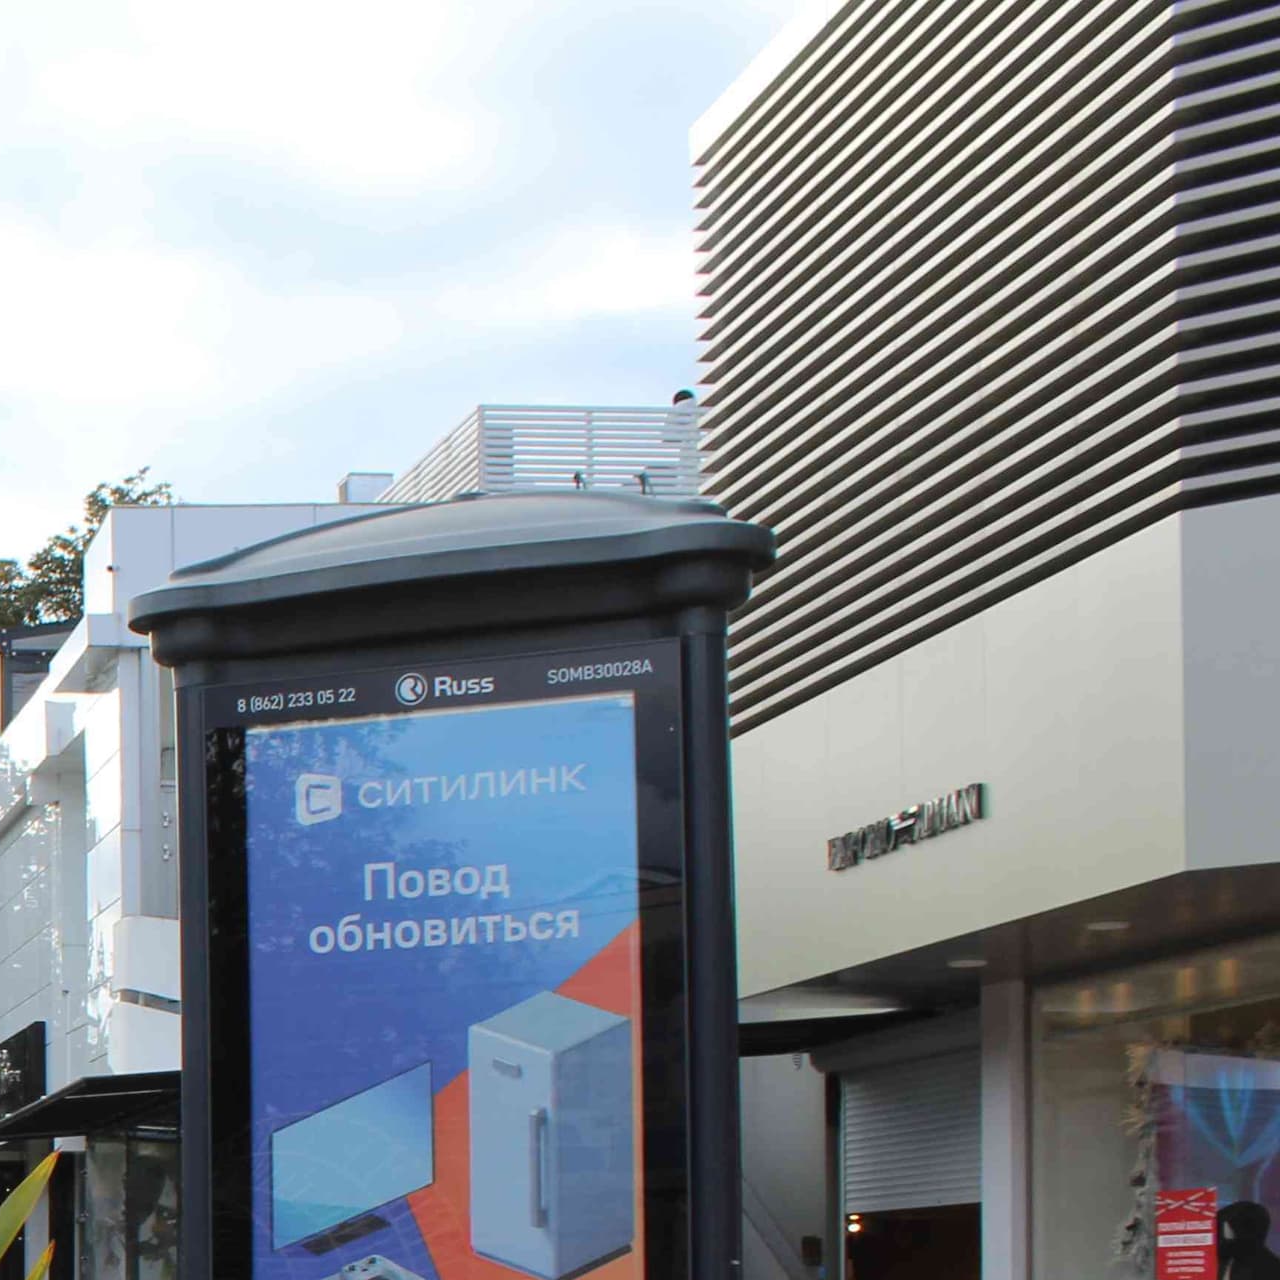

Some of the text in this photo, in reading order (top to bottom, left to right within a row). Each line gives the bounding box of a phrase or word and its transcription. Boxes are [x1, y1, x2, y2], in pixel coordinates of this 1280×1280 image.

[433, 676, 495, 698] Russ
[547, 659, 653, 684] SOMB30028A
[237, 688, 356, 713] 8 (862) 233 05 22
[358, 763, 587, 809] СИТИЛИНК
[363, 862, 511, 902] Повод
[309, 909, 580, 954] обновиться
